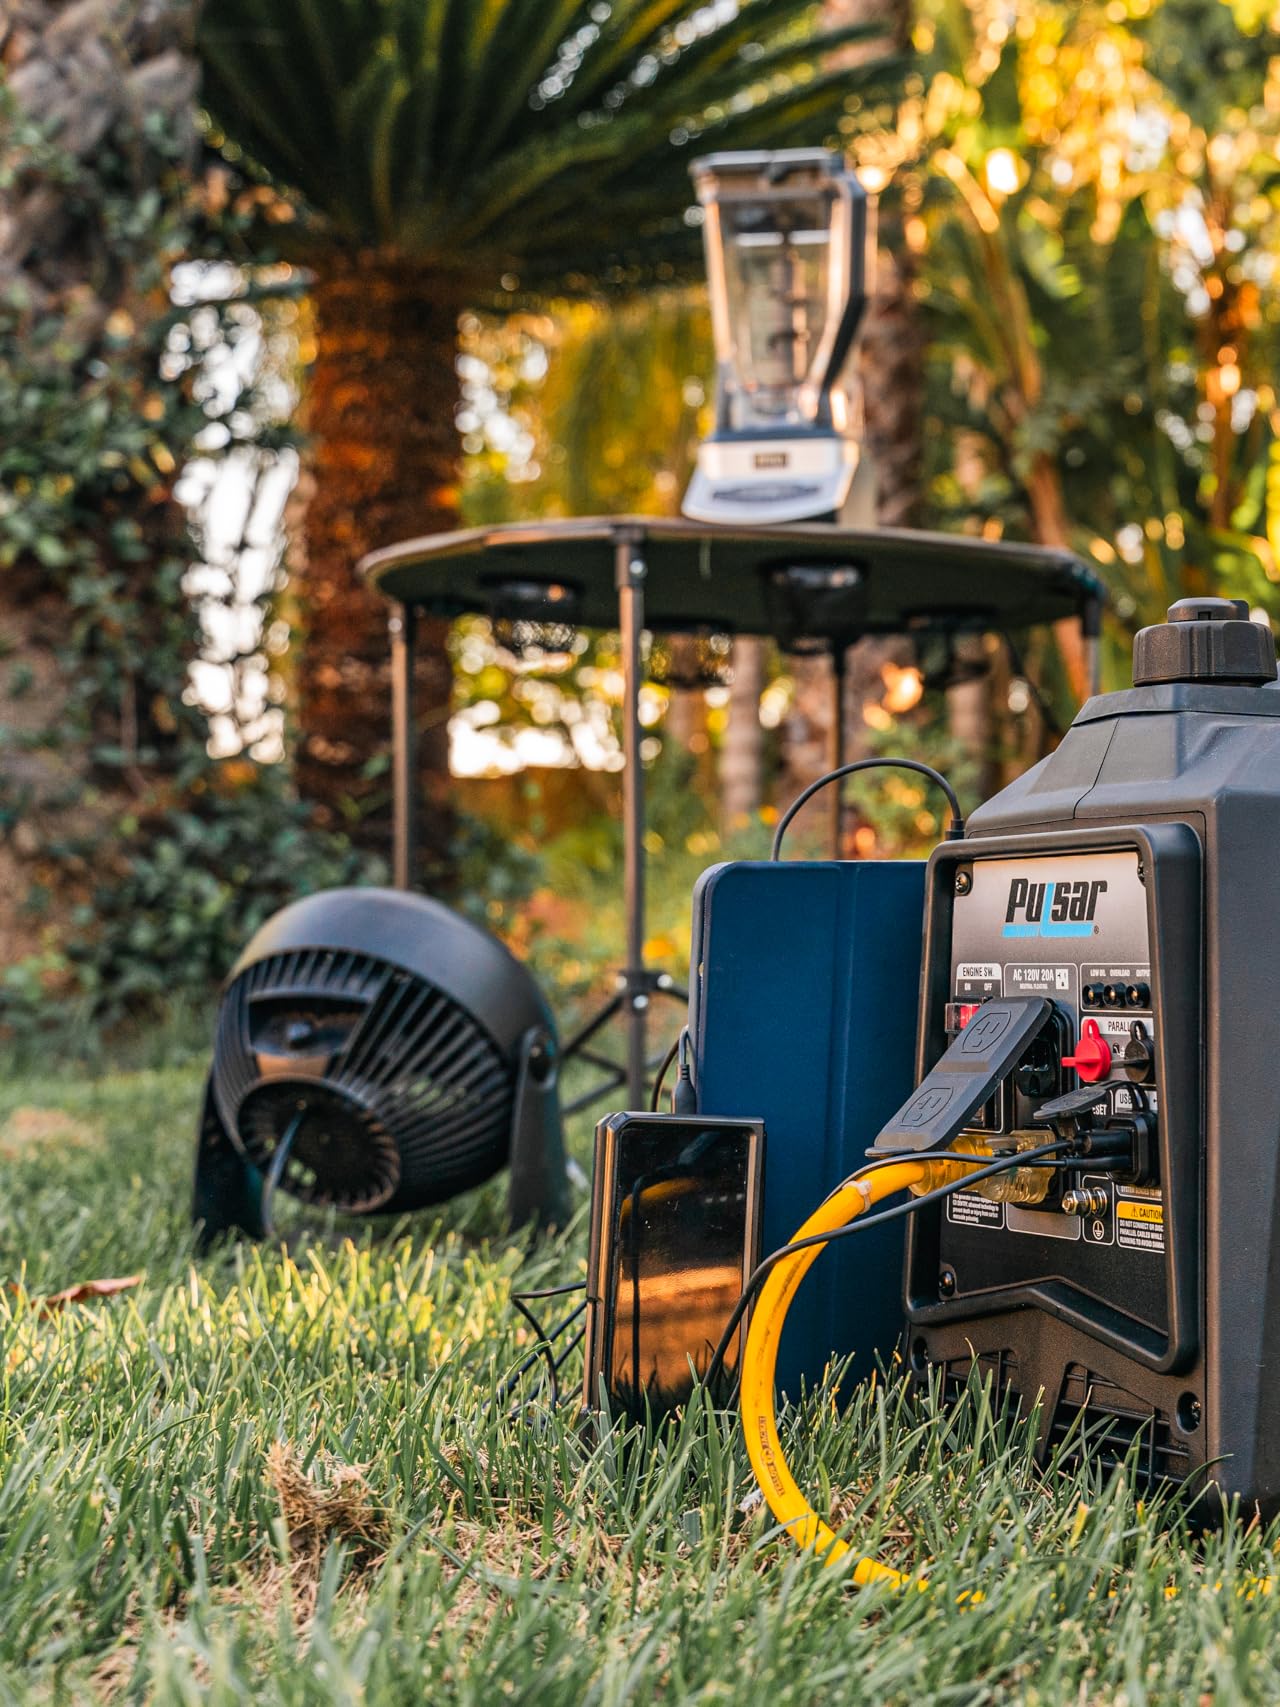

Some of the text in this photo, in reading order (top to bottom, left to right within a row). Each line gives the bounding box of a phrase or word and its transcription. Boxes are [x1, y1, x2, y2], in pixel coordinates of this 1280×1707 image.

[1003, 878, 1108, 937] Pulsar
[962, 967, 982, 977] ENGINE
[1013, 969, 1054, 981] AC 120V 20A
[984, 983, 993, 991] OFF
